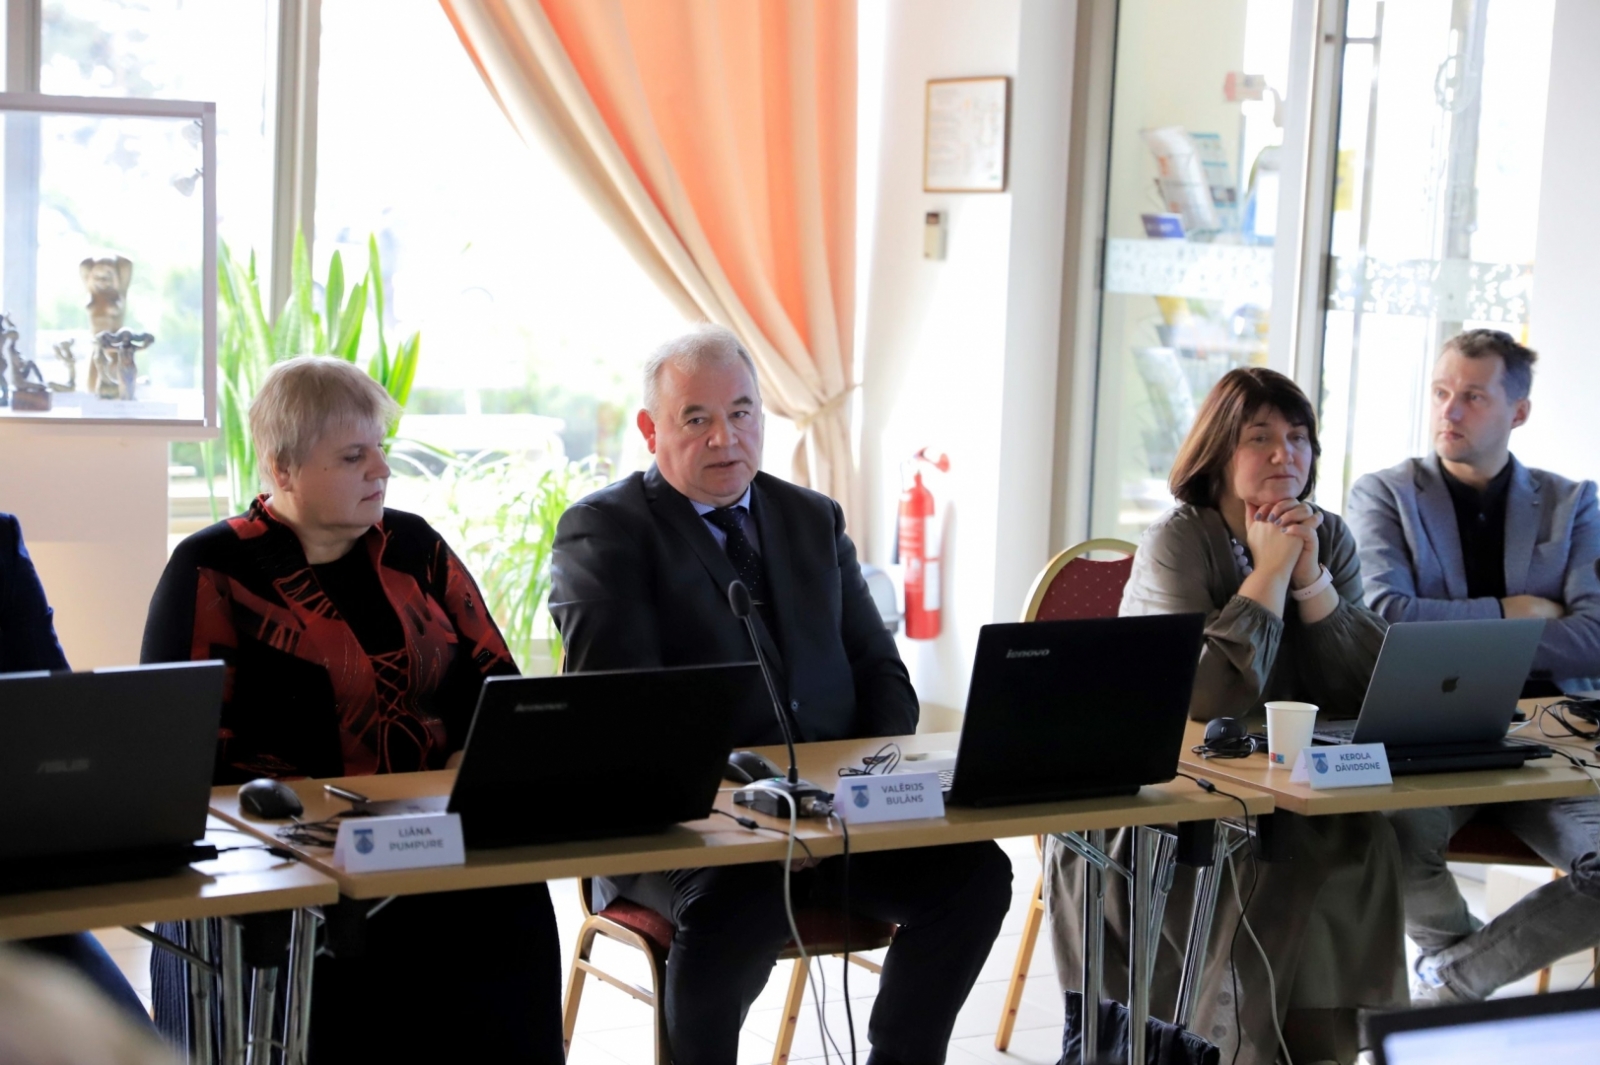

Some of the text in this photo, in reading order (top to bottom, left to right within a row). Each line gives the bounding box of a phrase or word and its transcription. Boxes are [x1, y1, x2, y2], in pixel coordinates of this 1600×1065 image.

[1340, 752, 1371, 762] KEROLA
[881, 782, 924, 793] VALĒRIJS
[886, 794, 923, 805] BULĀNS
[398, 826, 432, 838] LIĀNA
[389, 839, 444, 851] PUMPURE
